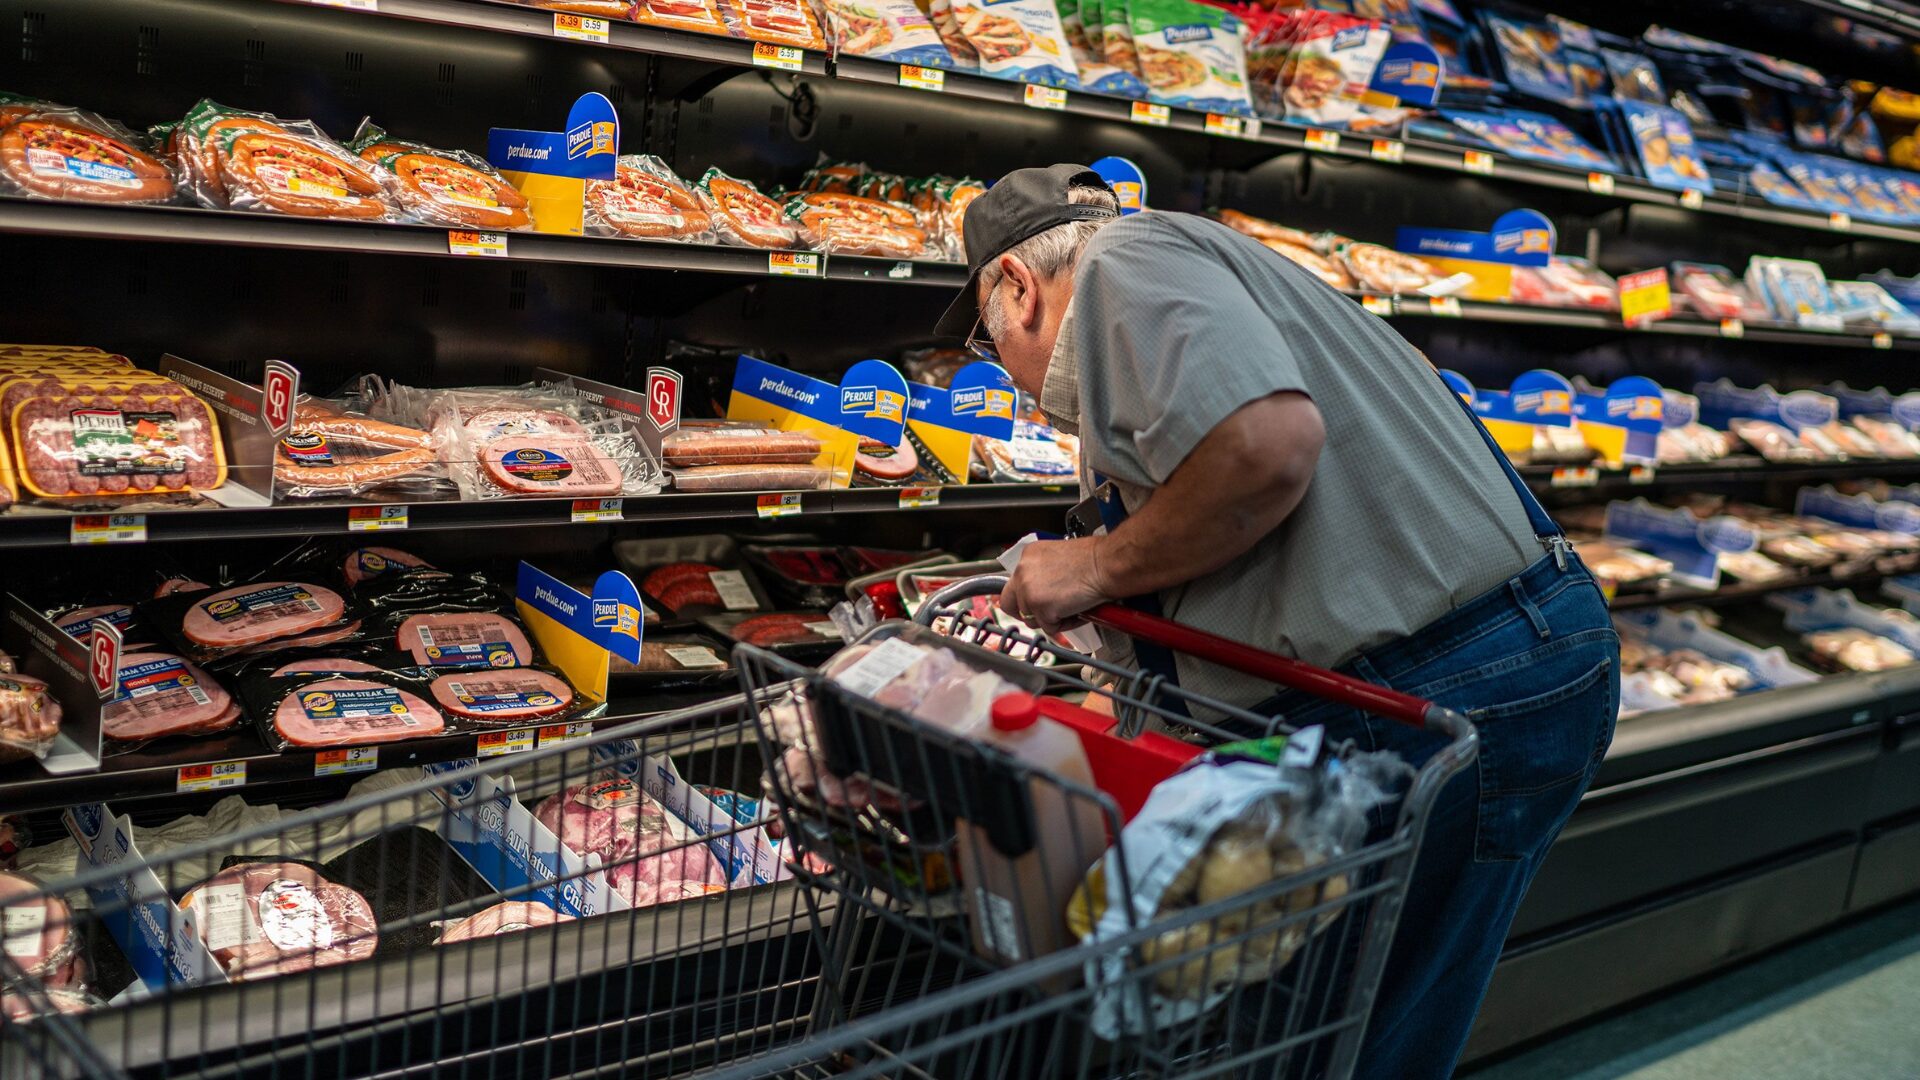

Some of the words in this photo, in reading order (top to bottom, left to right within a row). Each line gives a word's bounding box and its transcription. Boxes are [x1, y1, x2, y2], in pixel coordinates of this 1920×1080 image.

[569, 127, 592, 147] PERDUE
[202, 382, 225, 400] RESERVE
[269, 377, 286, 420] CR
[578, 391, 603, 404] RESERVE
[653, 380, 670, 417] CR
[844, 391, 874, 402] PERDUE
[954, 391, 983, 404] PERDUE
[237, 593, 258, 602] HAM
[258, 587, 284, 596] STEAK
[595, 603, 617, 615] PERDUE
[65, 623, 88, 634] HAM
[95, 637, 109, 683] CR
[118, 668, 138, 678] HAM
[140, 662, 168, 673] STEAK
[127, 678, 151, 688] HONEY
[357, 690, 384, 698] STEAK
[303, 694, 333, 710] Hatfield
[479, 803, 505, 837] 100%
[505, 829, 523, 854] All
